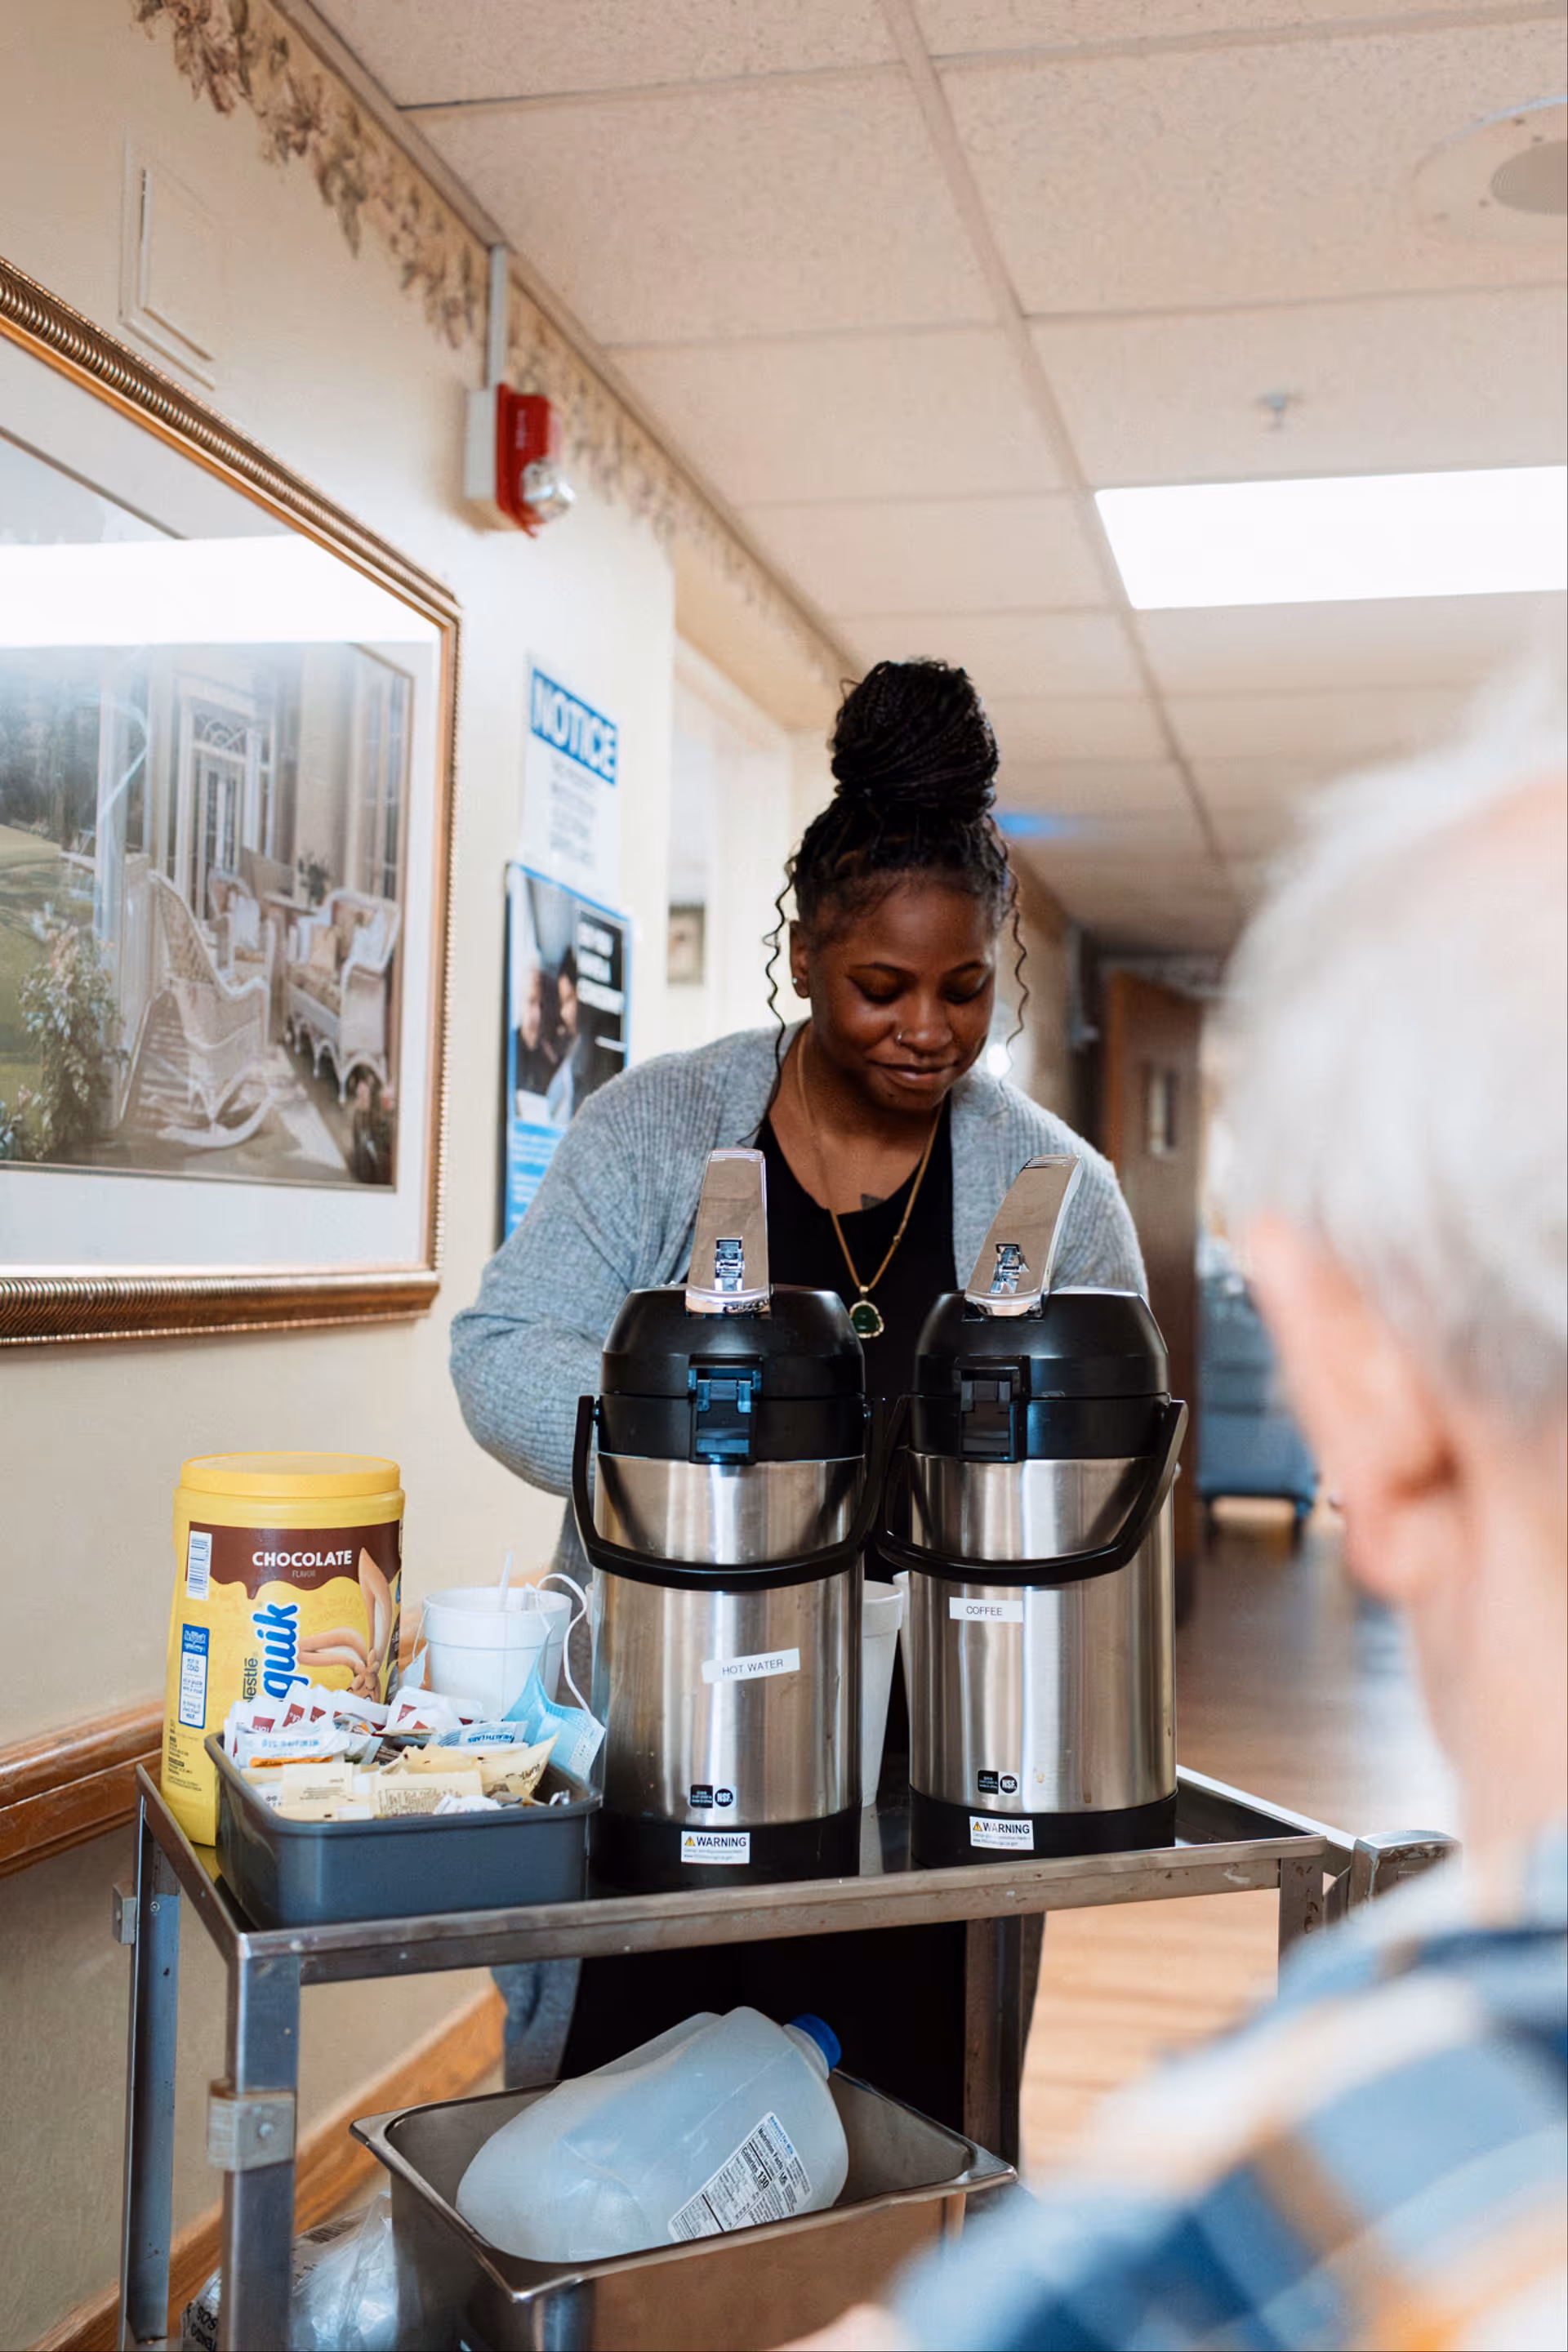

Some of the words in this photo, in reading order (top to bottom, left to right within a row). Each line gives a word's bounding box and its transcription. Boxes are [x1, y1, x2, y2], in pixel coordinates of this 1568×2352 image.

[536, 676, 615, 777] NOTICE
[252, 1550, 352, 1566] CHOCOLATE
[292, 1570, 316, 1579] FLAVOR
[966, 1606, 1003, 1616] COFFEE
[722, 1664, 744, 1675] HOT
[747, 1659, 784, 1672] WATER
[982, 1822, 1030, 1834] WARNING
[697, 1836, 746, 1846] WARNING
[758, 2127, 775, 2154] Nutrition
[773, 2152, 783, 2170] Facts
[758, 2171, 770, 2189] 130
